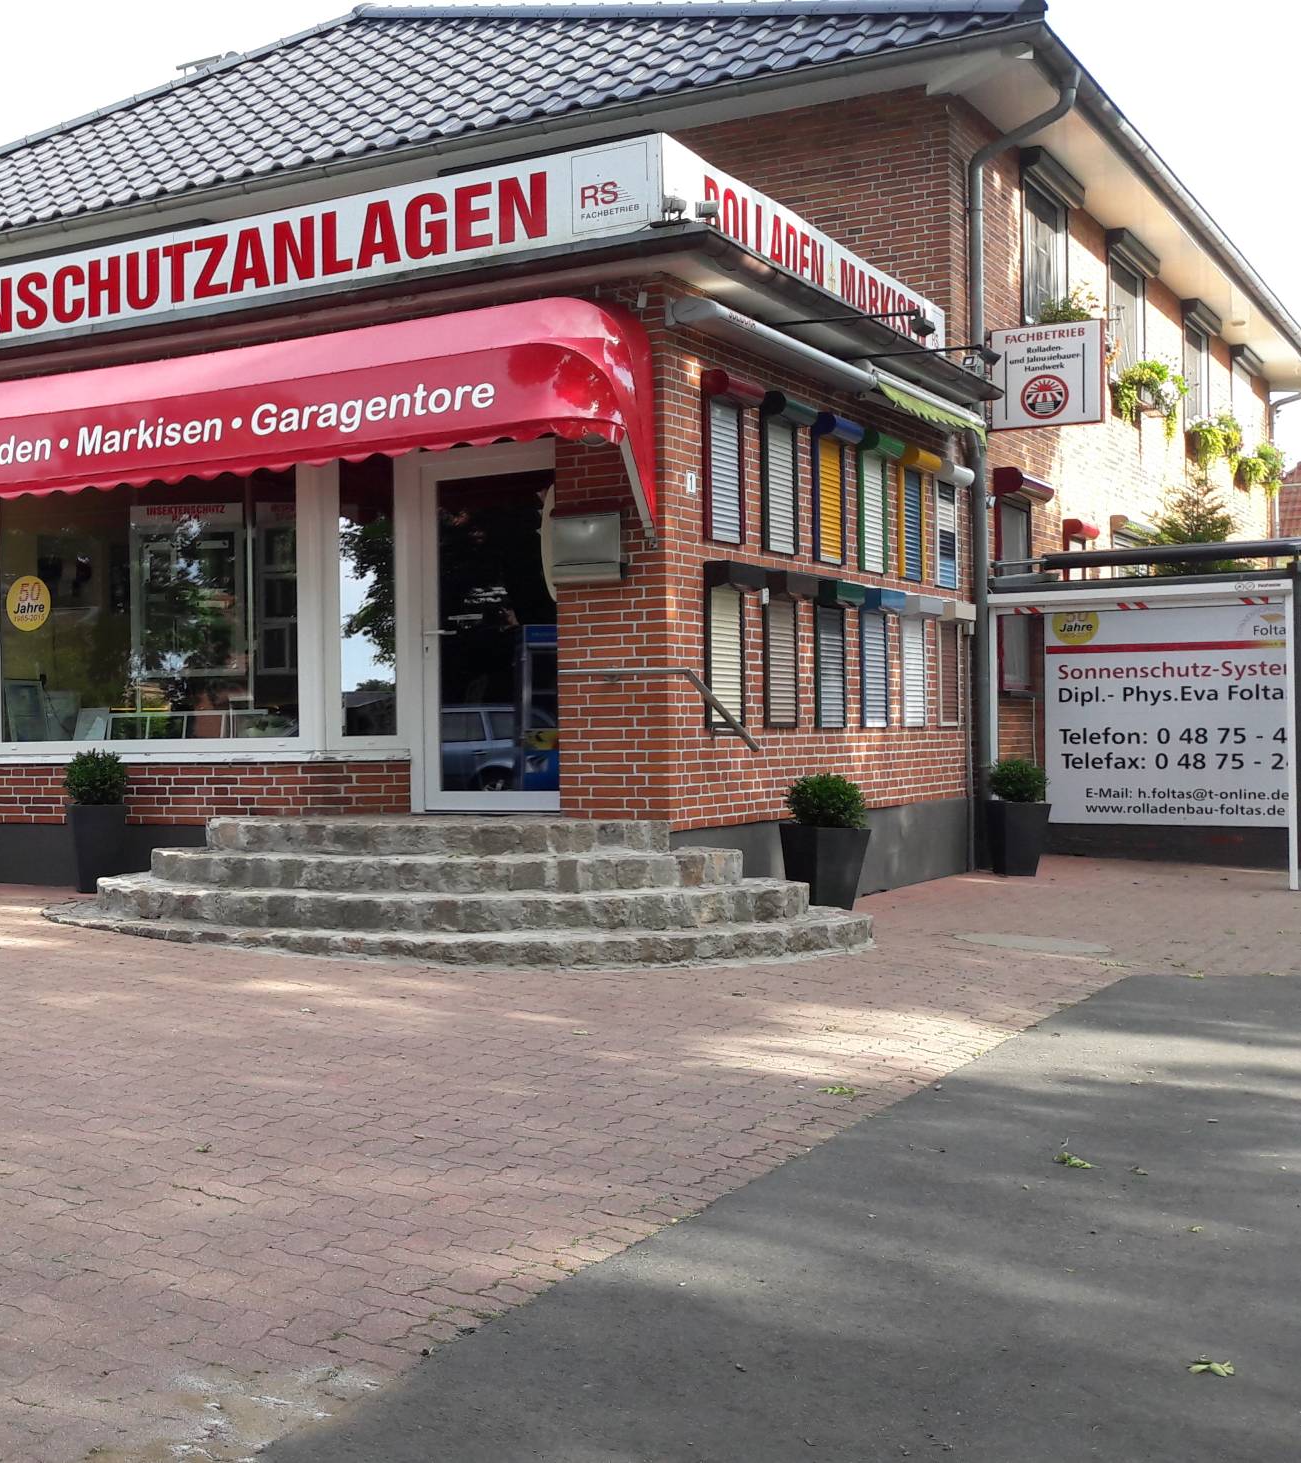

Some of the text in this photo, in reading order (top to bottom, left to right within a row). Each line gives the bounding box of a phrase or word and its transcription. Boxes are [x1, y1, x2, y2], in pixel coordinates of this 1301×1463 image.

[581, 181, 619, 209] RS
[580, 203, 641, 220] FACHBETRIEB
[1004, 327, 1086, 344] FACHBETRIEB
[1009, 356, 1025, 365] und
[1024, 361, 1065, 372] Handwerk
[75, 415, 223, 457] Markisen
[250, 382, 496, 437] Garagentore
[19, 582, 42, 602] 50
[13, 602, 45, 614] Jahre
[1060, 622, 1094, 633] Jahre
[1058, 660, 1287, 681] Sonnenschutz-Syste
[1058, 686, 1115, 706] Dipl.-
[1228, 684, 1288, 701] Folta
[1059, 727, 1148, 745] Telefon:
[1156, 727, 1171, 745] 0
[1179, 727, 1209, 745] 48
[1217, 727, 1247, 745] 75
[1061, 752, 1147, 770] Telefax:
[1155, 752, 1169, 770] 0
[1177, 752, 1207, 770] 48
[1215, 752, 1245, 770] 75
[1271, 752, 1288, 770] 2
[1085, 787, 1290, 801] E-Mail: h.foltas@t-online.de
[1085, 803, 1286, 816] www.rolladenbau-foltas.de
